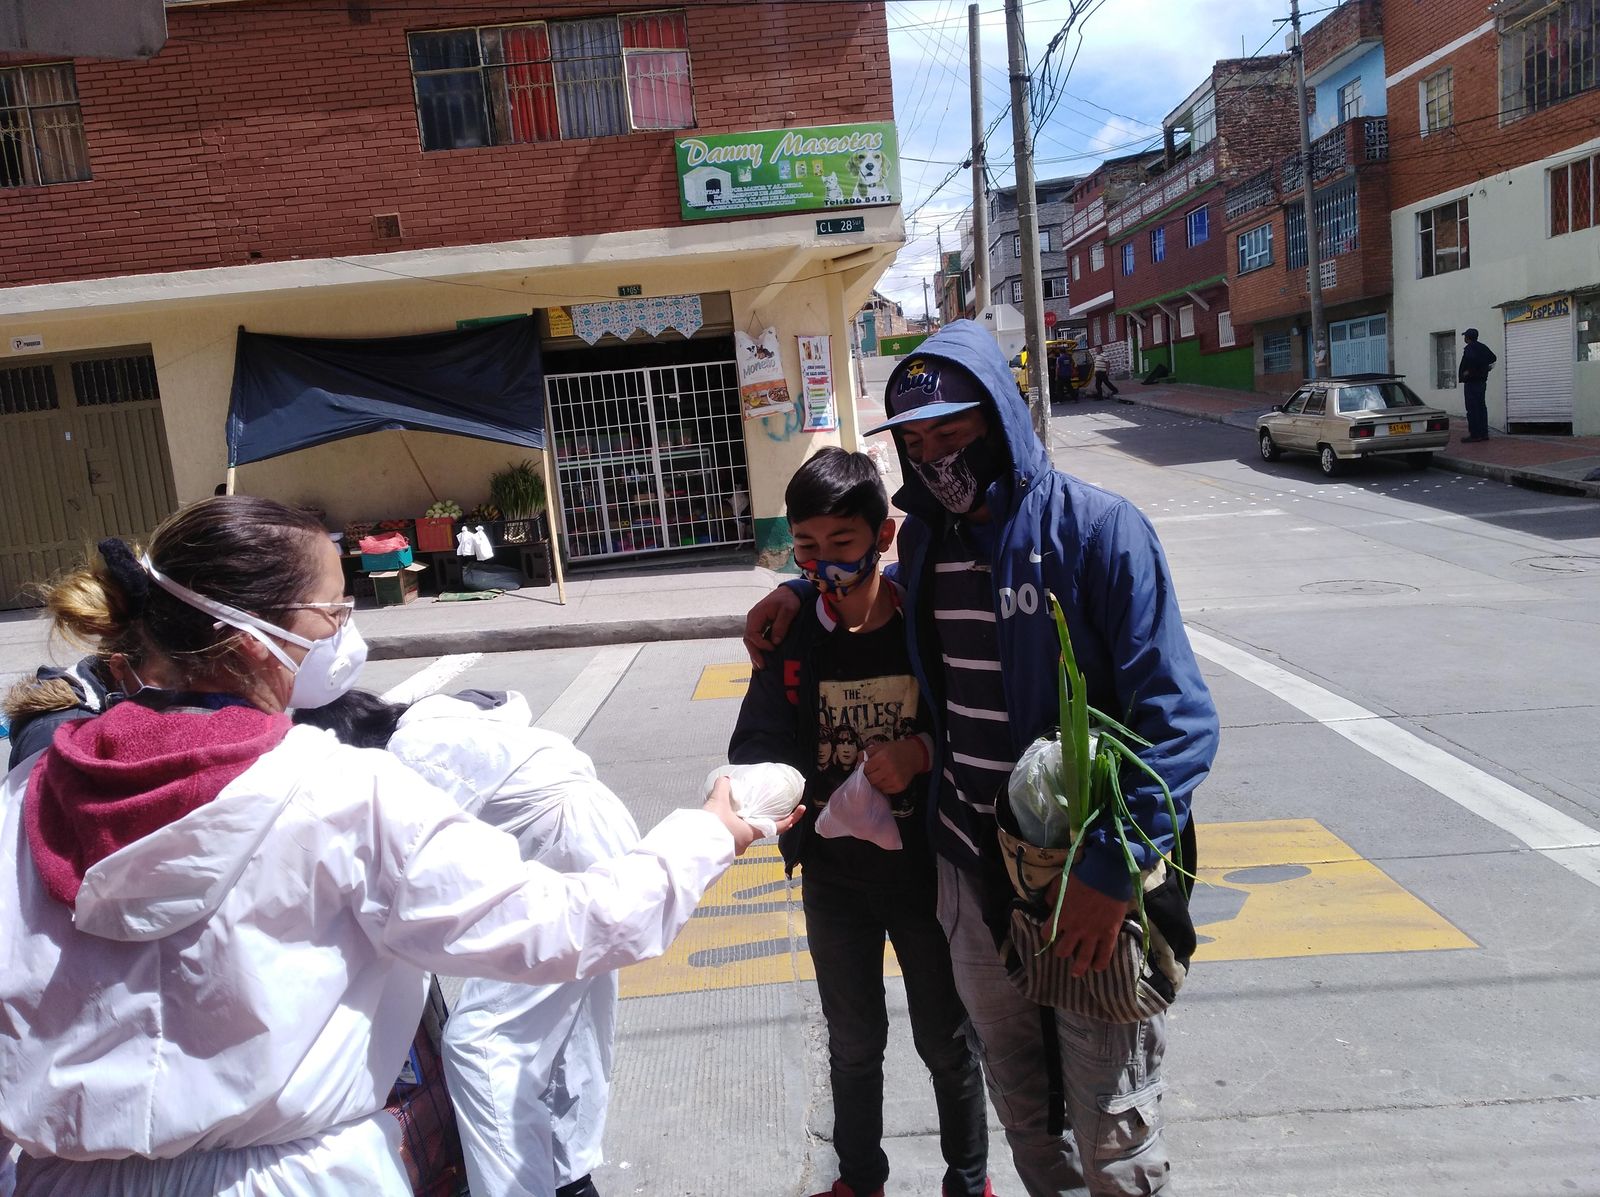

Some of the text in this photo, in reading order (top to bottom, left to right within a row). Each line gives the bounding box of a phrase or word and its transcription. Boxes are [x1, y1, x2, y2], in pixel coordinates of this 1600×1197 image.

[680, 132, 883, 168] Danny Mascotas
[820, 222, 833, 233] CL
[841, 220, 853, 231] 28
[998, 582, 1039, 620] DO
[843, 688, 861, 700] THE
